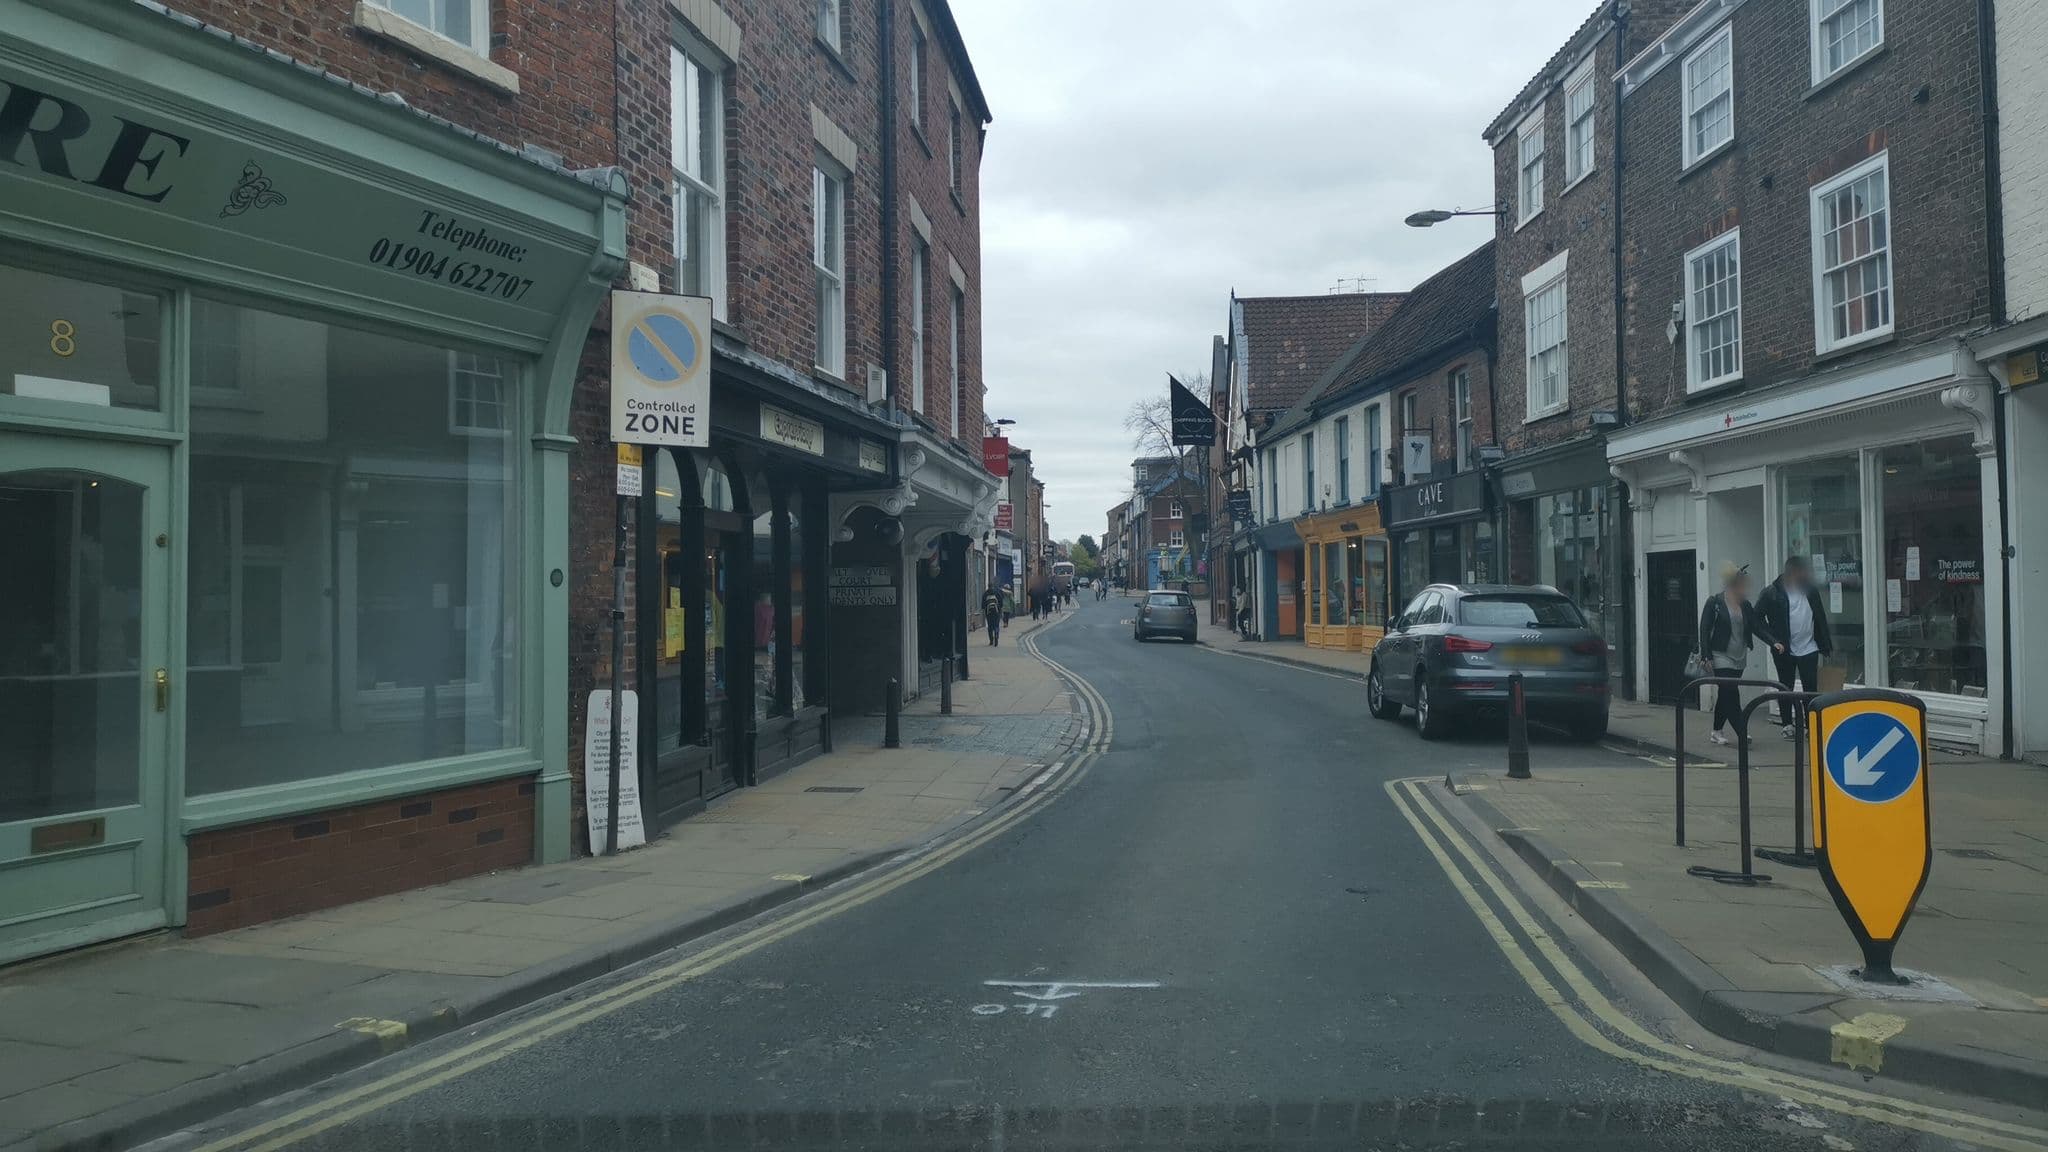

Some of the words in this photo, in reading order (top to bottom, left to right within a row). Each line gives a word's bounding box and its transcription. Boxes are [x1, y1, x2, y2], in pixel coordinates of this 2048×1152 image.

[369, 237, 450, 280] 01904
[449, 261, 534, 301] 622707
[50, 319, 75, 356] 8
[627, 398, 696, 414] Controlled
[625, 412, 695, 436] ZONE
[1418, 483, 1443, 506] CAVE
[1937, 560, 1951, 571] The
[1953, 561, 1976, 573] power
[839, 576, 872, 585] COURT
[1938, 573, 1947, 581] of
[1946, 571, 1980, 581] kindness
[835, 587, 873, 597] PRIVATE
[869, 595, 896, 606] ONLY
